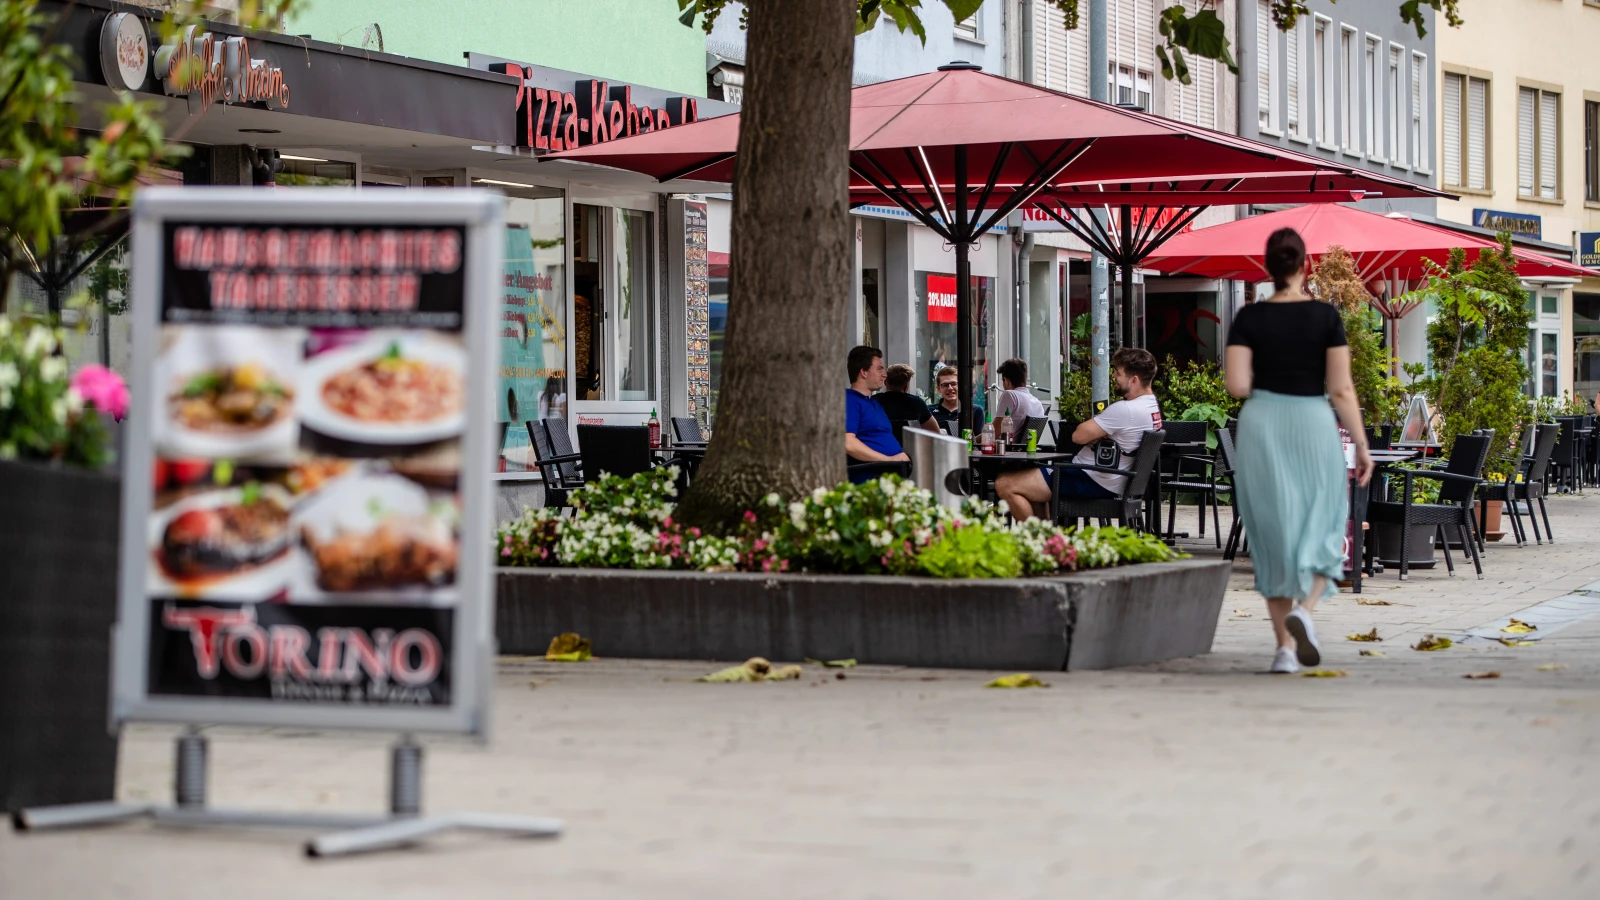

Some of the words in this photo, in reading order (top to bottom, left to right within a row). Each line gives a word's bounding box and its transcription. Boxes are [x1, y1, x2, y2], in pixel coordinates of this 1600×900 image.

[238, 37, 290, 108] Dream
[209, 269, 421, 311] TAGESESSEN
[927, 291, 940, 307] 20%
